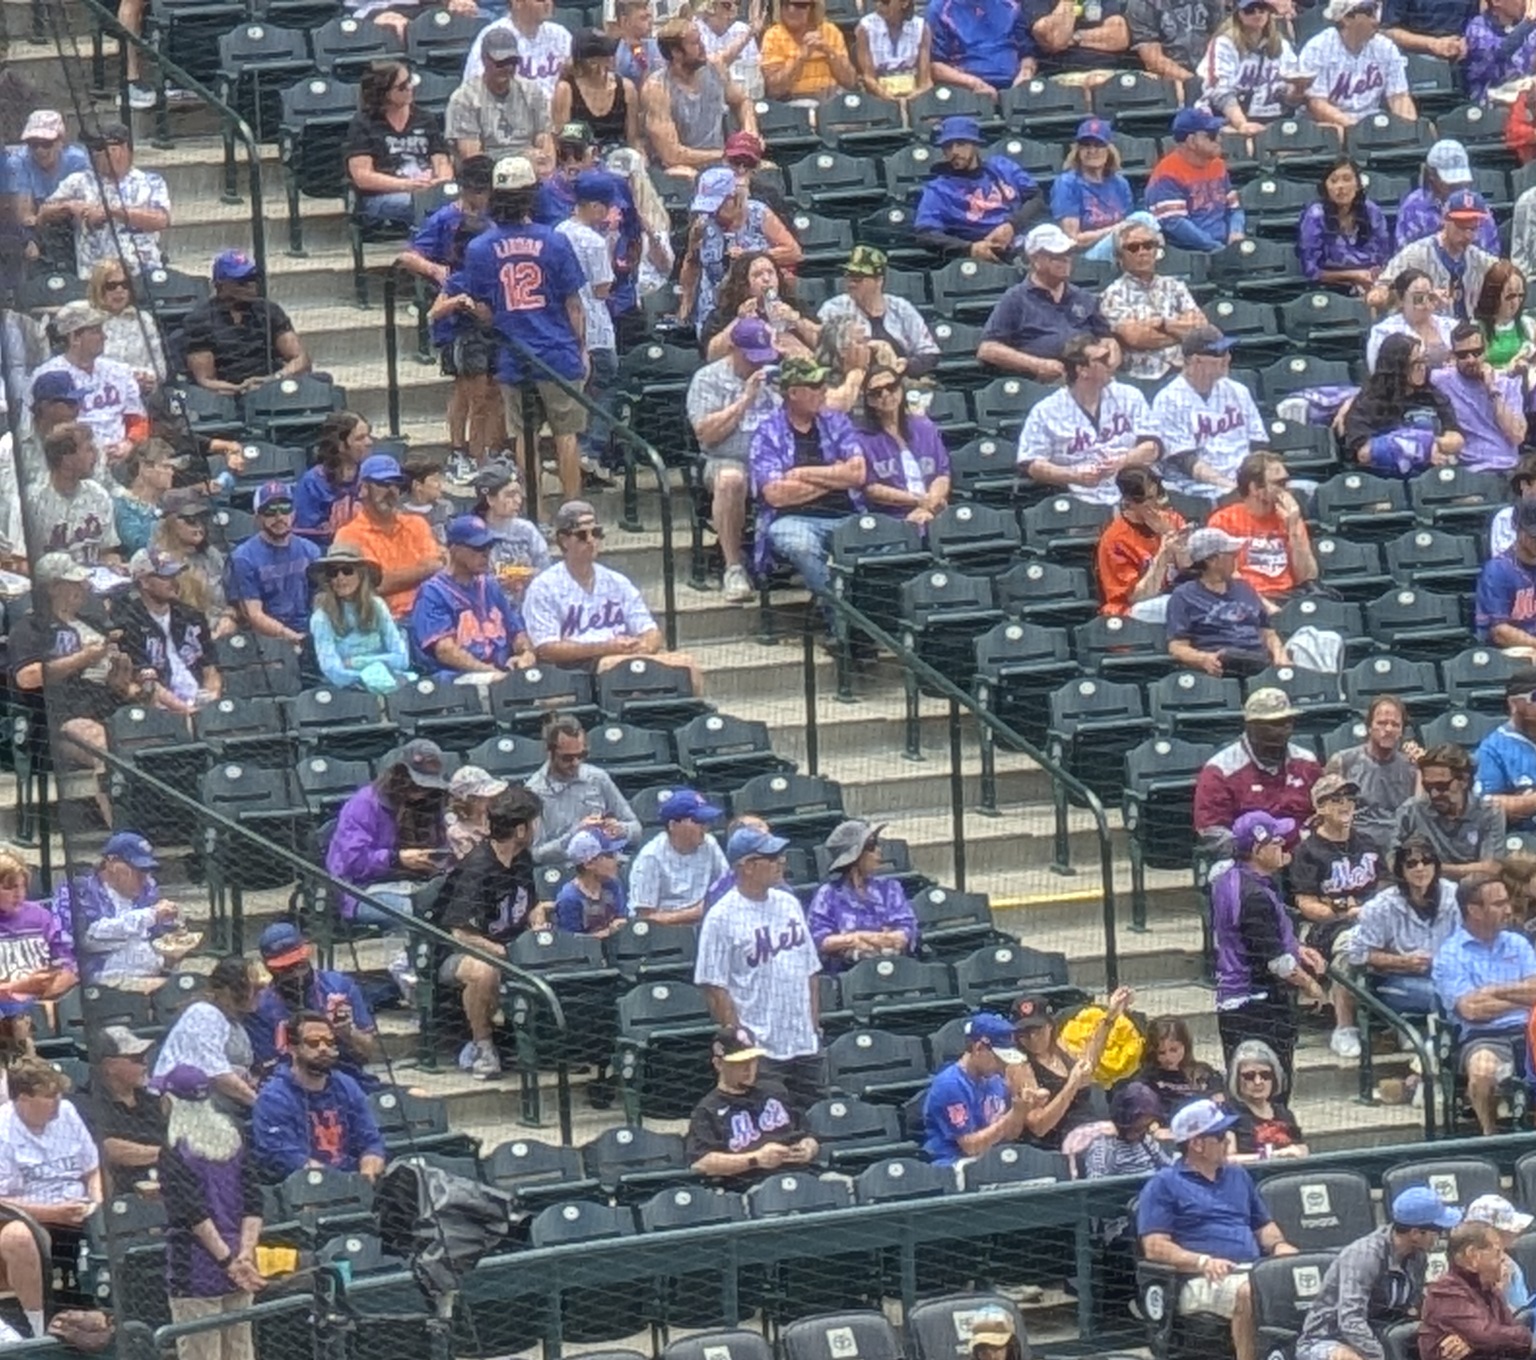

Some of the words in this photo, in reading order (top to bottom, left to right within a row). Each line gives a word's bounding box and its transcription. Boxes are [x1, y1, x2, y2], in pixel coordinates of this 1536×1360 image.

[1331, 53, 1384, 100] Mets
[500, 262, 546, 311] 12
[1068, 413, 1131, 453] Mets
[1195, 403, 1245, 441] Mets
[561, 604, 625, 635] Mets
[746, 918, 805, 968] Mets
